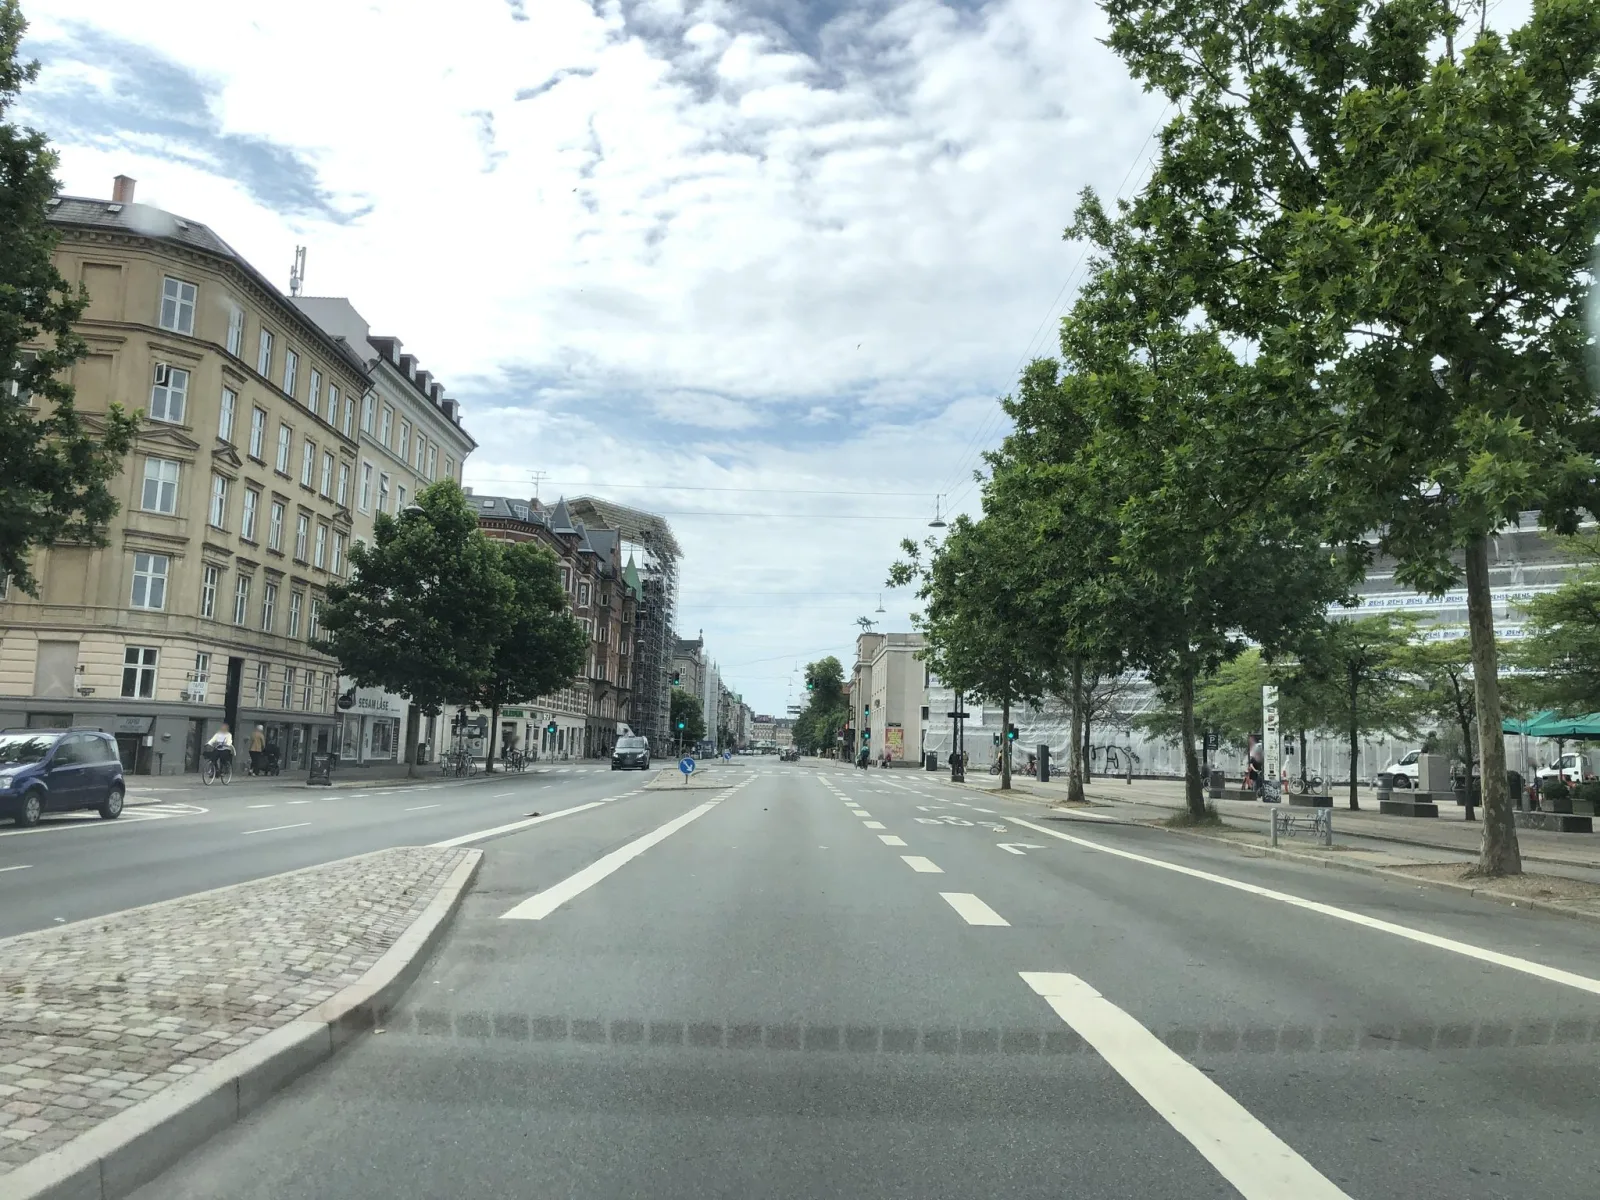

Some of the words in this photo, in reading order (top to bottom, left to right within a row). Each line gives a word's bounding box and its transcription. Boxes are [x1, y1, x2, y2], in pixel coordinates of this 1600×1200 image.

[358, 698, 376, 709] SESAM
[376, 696, 389, 711] LÅSE
[1209, 736, 1216, 744] P
